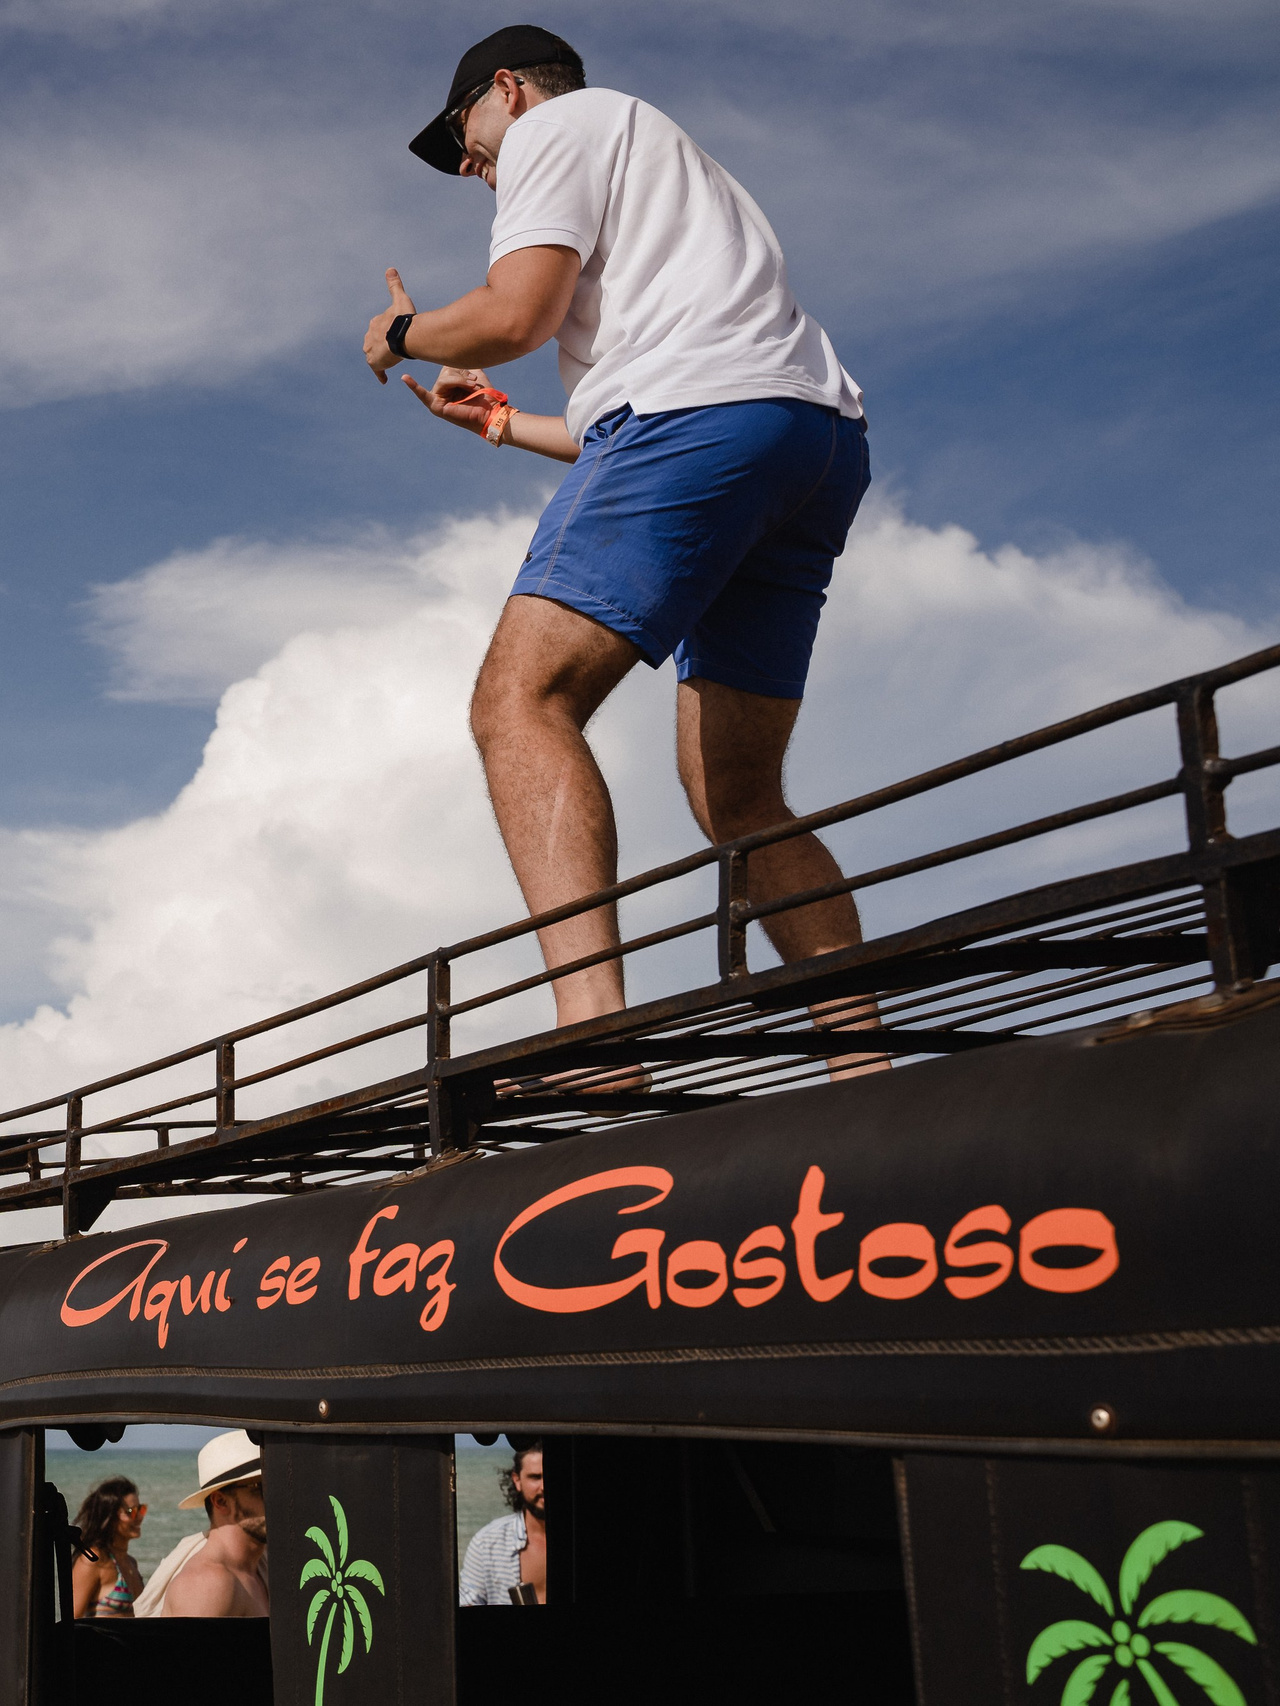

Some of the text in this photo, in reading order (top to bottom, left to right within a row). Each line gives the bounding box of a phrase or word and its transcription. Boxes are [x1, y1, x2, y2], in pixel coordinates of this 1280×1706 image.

[60, 1165, 1120, 1349] Aqui se faz Gostoso
